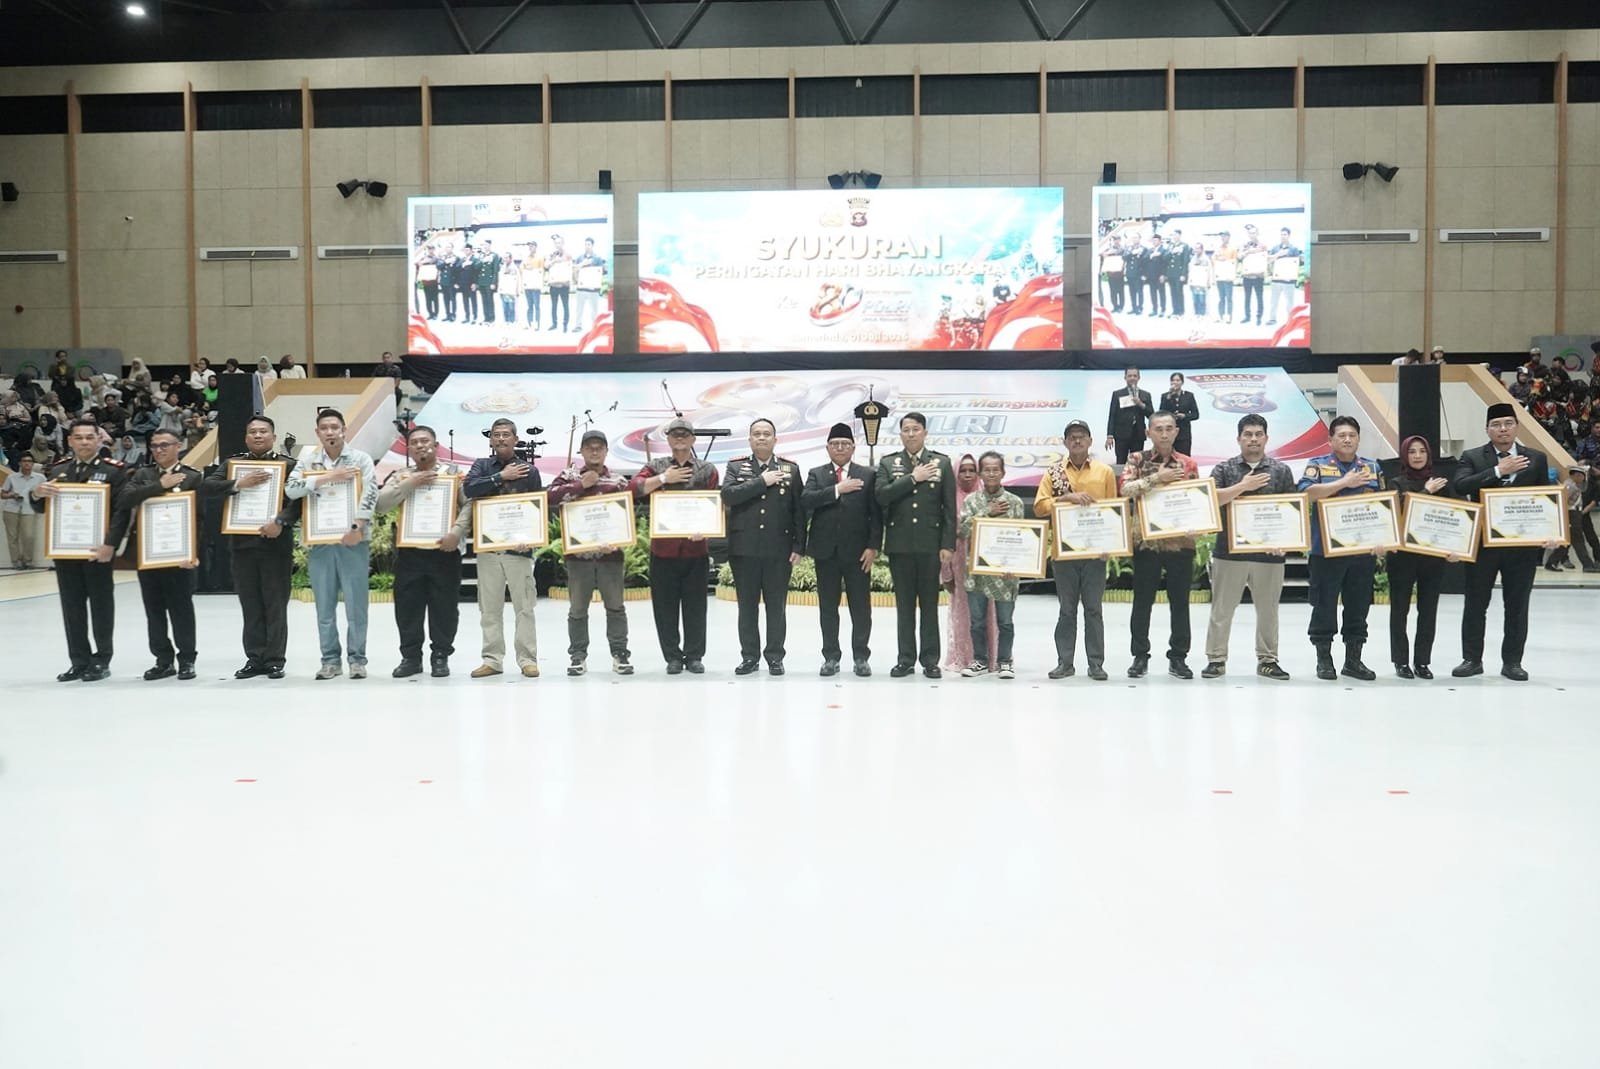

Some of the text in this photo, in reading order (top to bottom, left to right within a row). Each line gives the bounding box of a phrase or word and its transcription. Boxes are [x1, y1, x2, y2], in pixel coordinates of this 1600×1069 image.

[756, 234, 943, 261] SYUKURAN
[694, 262, 1007, 280] PERINGATAN HARI BHAYANGKARA
[900, 397, 1068, 410] Tahun Mengabdi
